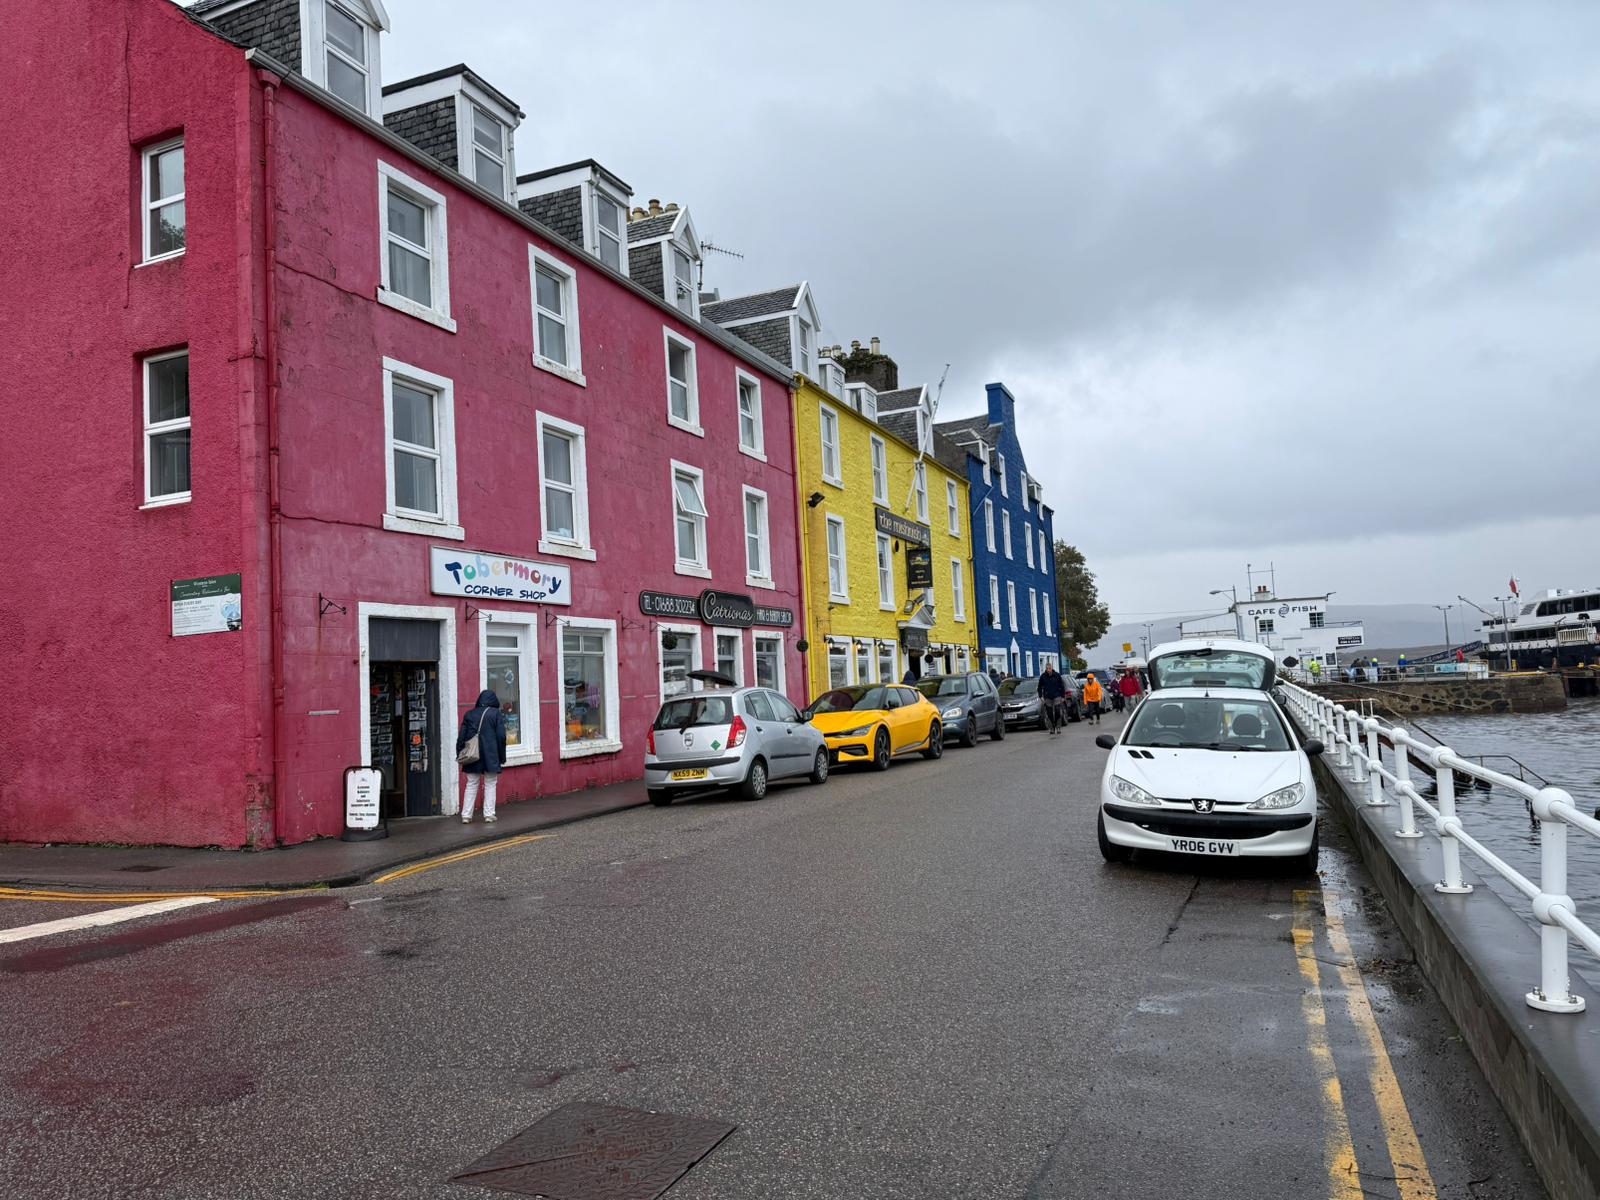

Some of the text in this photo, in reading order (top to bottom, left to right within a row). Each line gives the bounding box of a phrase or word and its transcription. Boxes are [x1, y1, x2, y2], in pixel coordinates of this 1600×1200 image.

[444, 554, 562, 595] Tobermory
[464, 584, 547, 600] CORNER SHOP
[1248, 605, 1317, 616] CAFE FISH
[1171, 839, 1234, 854] YR06 GVV
